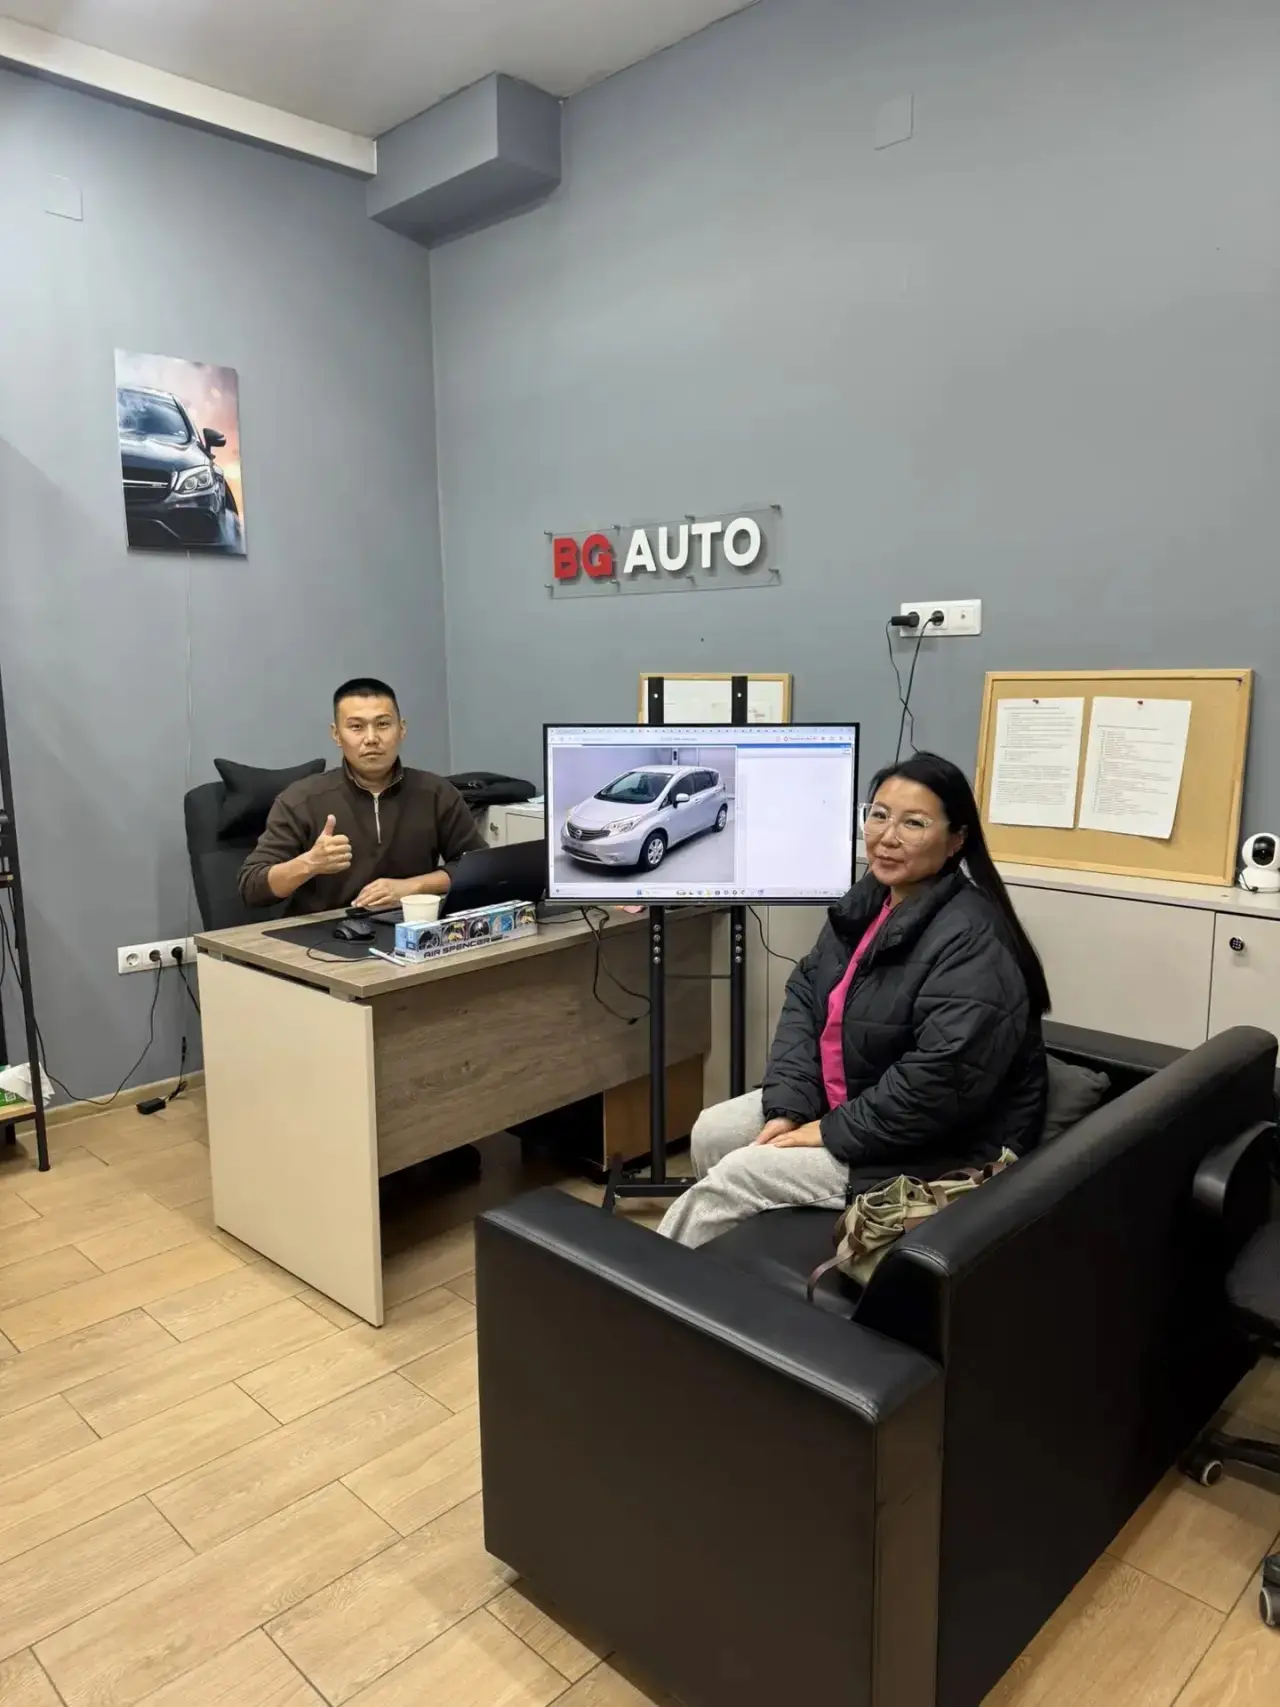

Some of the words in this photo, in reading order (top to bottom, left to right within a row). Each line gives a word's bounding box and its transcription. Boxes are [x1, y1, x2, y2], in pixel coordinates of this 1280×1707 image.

[553, 533, 612, 578] BG
[623, 517, 761, 574] AUTO
[424, 949, 441, 958] AIR
[443, 938, 490, 954] SPENCER
